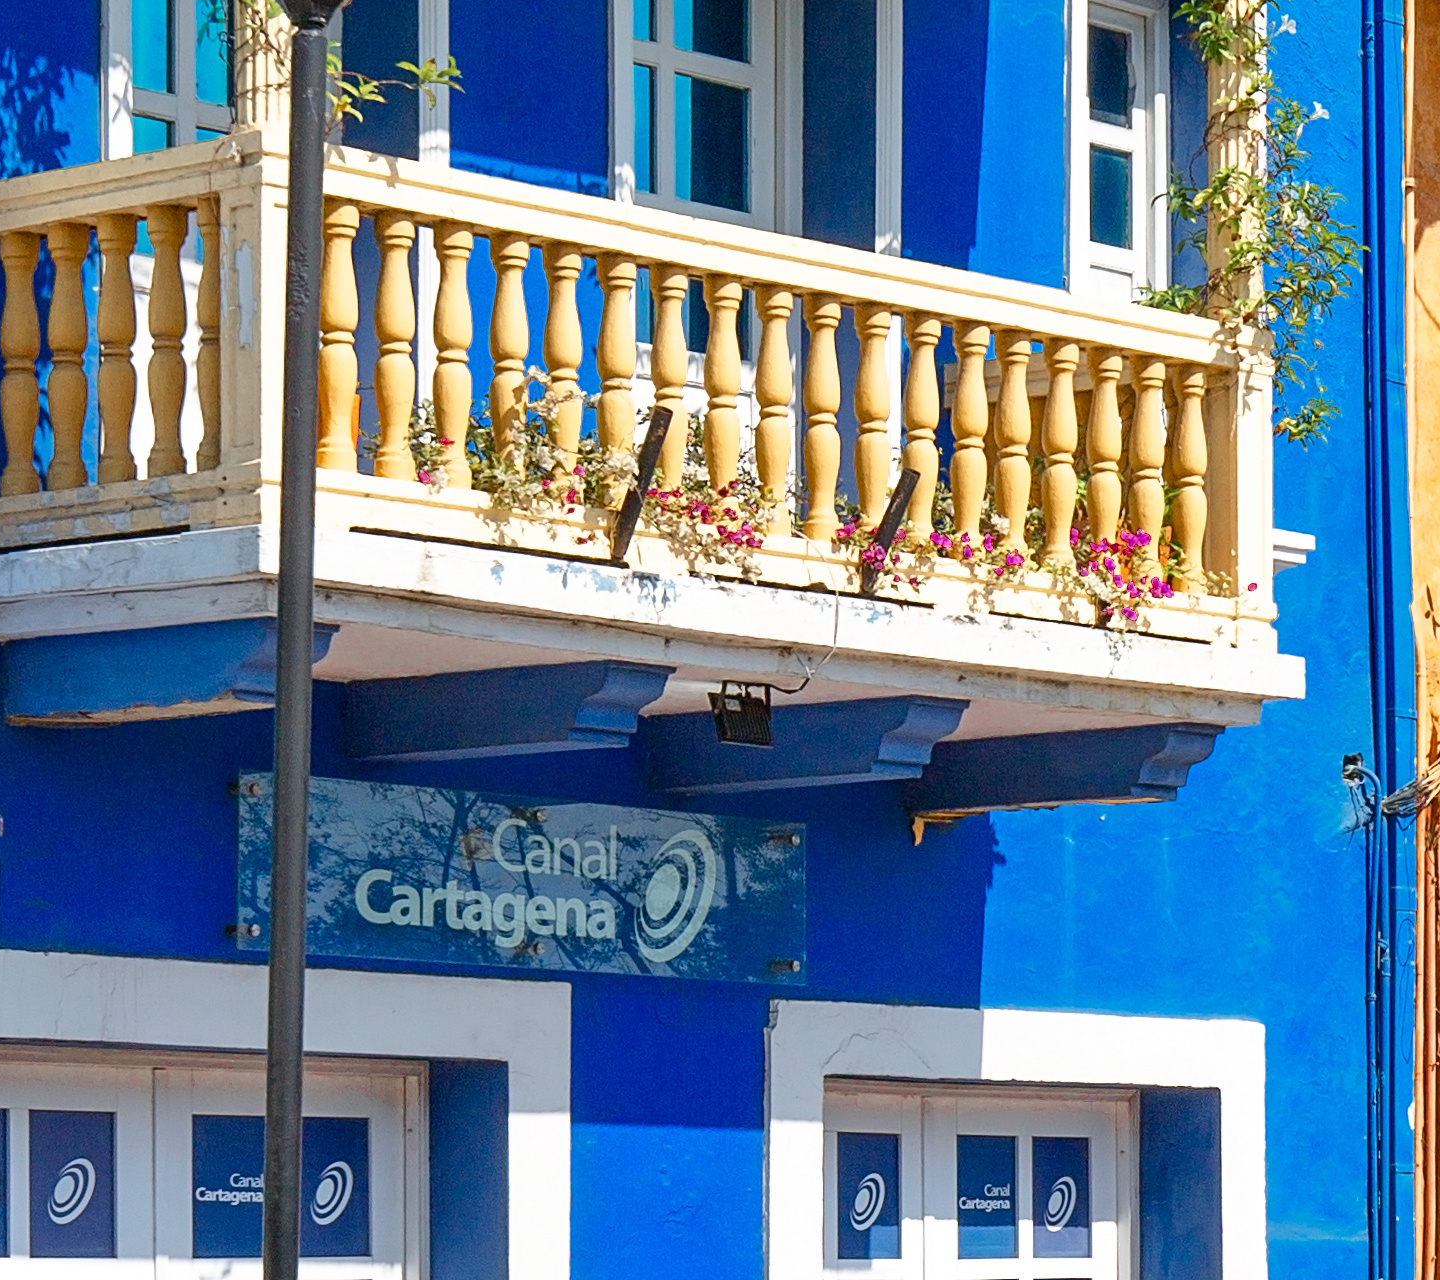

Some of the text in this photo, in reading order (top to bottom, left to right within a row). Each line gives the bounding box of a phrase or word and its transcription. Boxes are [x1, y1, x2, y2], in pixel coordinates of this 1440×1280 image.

[492, 817, 618, 882] Canal
[354, 868, 616, 949] Cartagena
[229, 1173, 265, 1188] Canal
[195, 1186, 264, 1205] Cartagena
[984, 1183, 1010, 1197] Canal
[959, 1197, 1010, 1212] Cartagena
